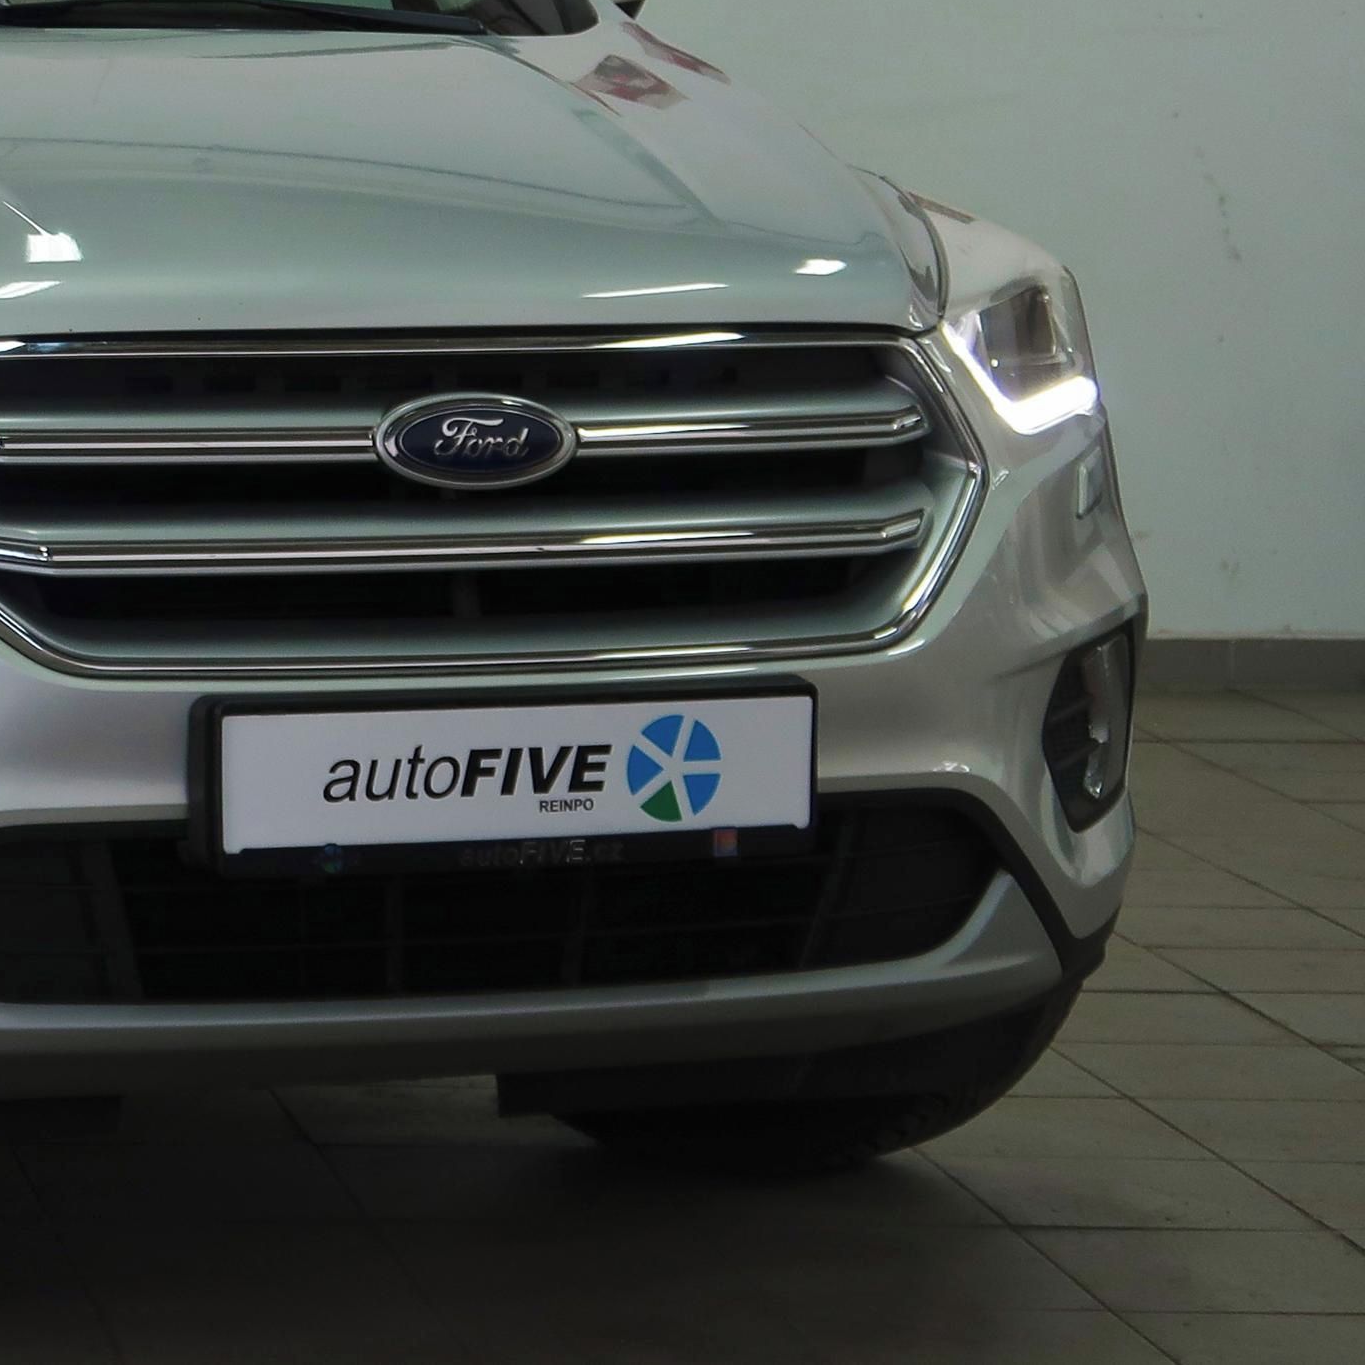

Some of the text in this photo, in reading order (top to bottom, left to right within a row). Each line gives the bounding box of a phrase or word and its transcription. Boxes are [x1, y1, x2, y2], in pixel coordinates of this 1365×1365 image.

[433, 417, 530, 458] Ford
[322, 744, 613, 803] autoFIVE
[538, 798, 595, 814] REINPO
